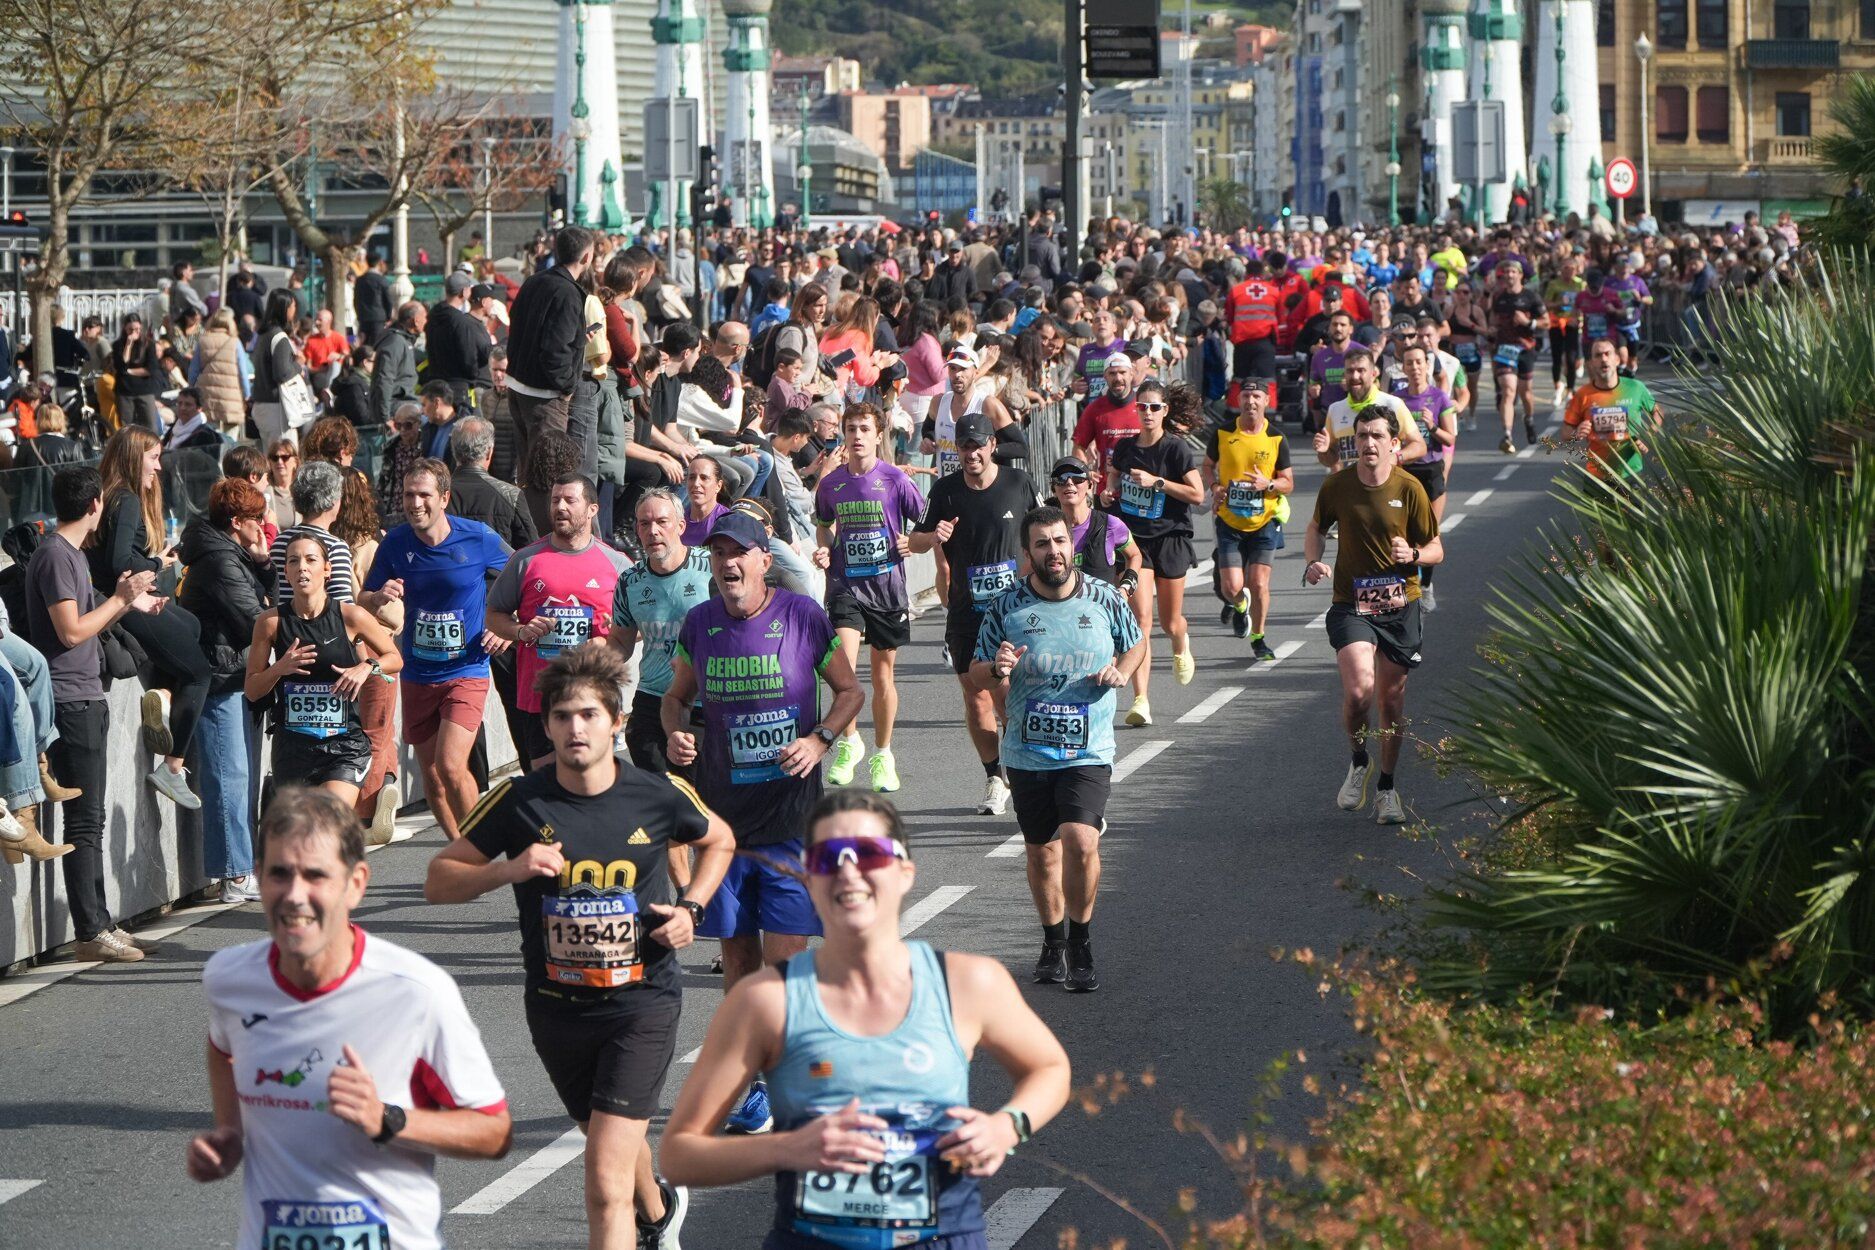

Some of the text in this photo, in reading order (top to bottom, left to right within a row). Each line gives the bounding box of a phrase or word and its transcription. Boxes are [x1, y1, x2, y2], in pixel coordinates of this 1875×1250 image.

[1614, 172, 1630, 184] 40
[1595, 416, 1626, 426] 15794
[1122, 482, 1151, 499] 11070
[1230, 489, 1263, 501] 8904
[836, 501, 883, 515] BEHOBIA
[856, 530, 882, 541] Joma
[847, 540, 886, 556] 8634
[983, 564, 1009, 575] Joma
[973, 574, 1013, 593] 7663
[1370, 577, 1398, 587] Joma
[1359, 586, 1402, 603] 4244
[425, 612, 456, 622] Joma
[553, 608, 585, 617] Joma
[416, 623, 460, 639] 7516
[549, 620, 587, 636] 426
[664, 640, 680, 657] 57
[706, 654, 782, 678] BEHOBIA
[706, 679, 724, 692] SAN
[1050, 674, 1068, 692] 57
[291, 697, 341, 713] 6559
[1044, 704, 1079, 714] Joma
[747, 709, 789, 726] Joma
[1029, 715, 1083, 735] 8353
[733, 724, 795, 750] 10007
[569, 899, 626, 917] Joma
[551, 921, 633, 946] 13542
[293, 1204, 368, 1227] Joma
[842, 1201, 890, 1215] MERCE
